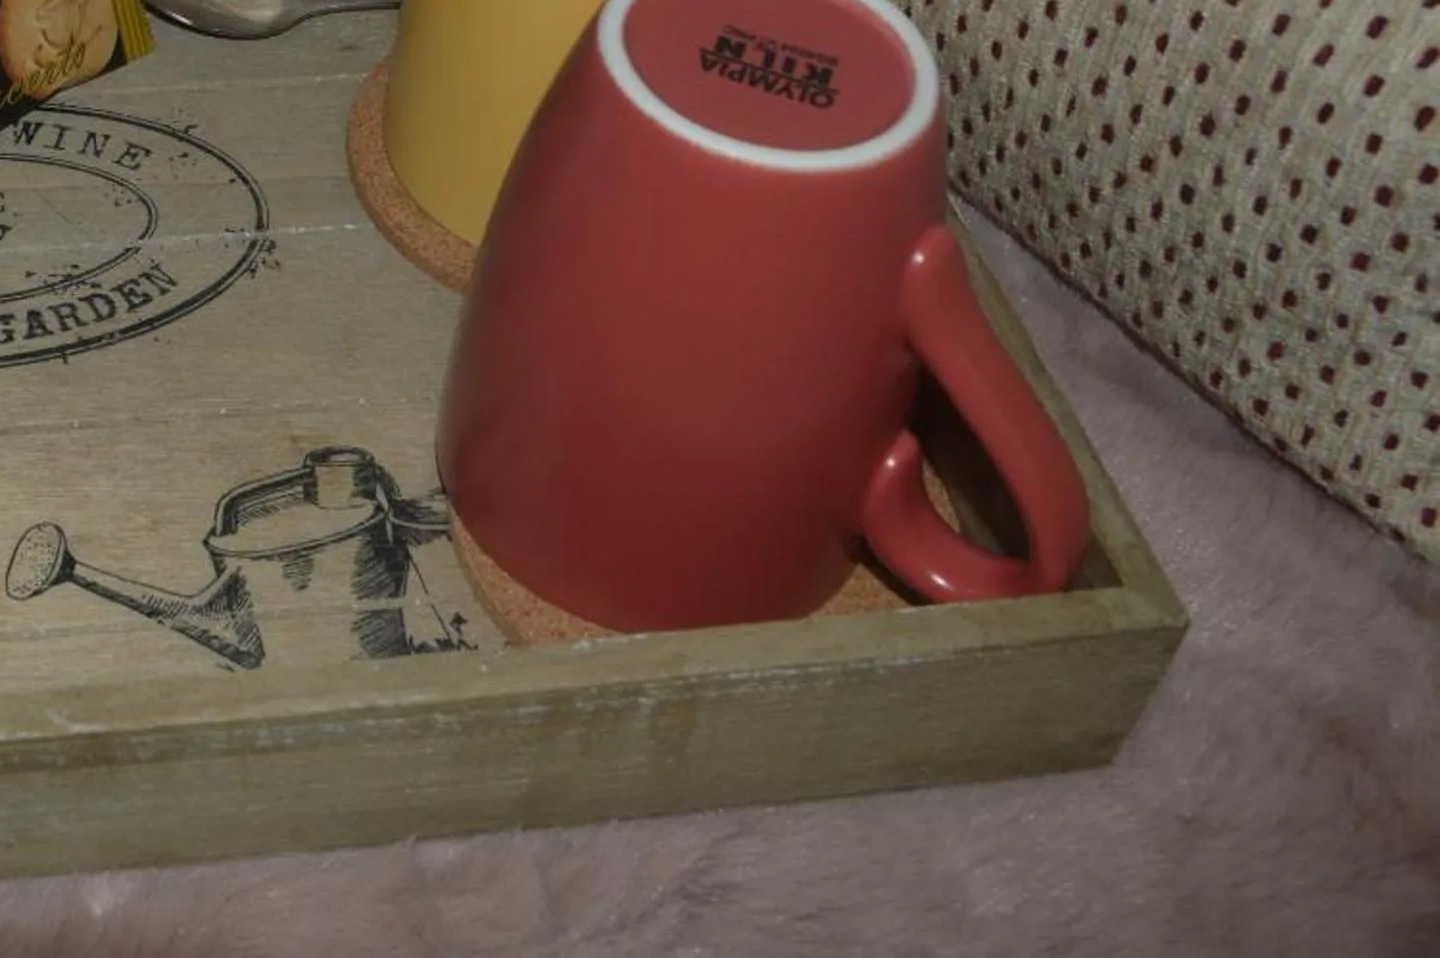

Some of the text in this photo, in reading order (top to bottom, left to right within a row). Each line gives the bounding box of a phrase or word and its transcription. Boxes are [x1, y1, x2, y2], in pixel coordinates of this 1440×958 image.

[700, 47, 835, 109] OLYMPIA
[714, 35, 834, 86] KILN
[13, 119, 153, 171] WINE
